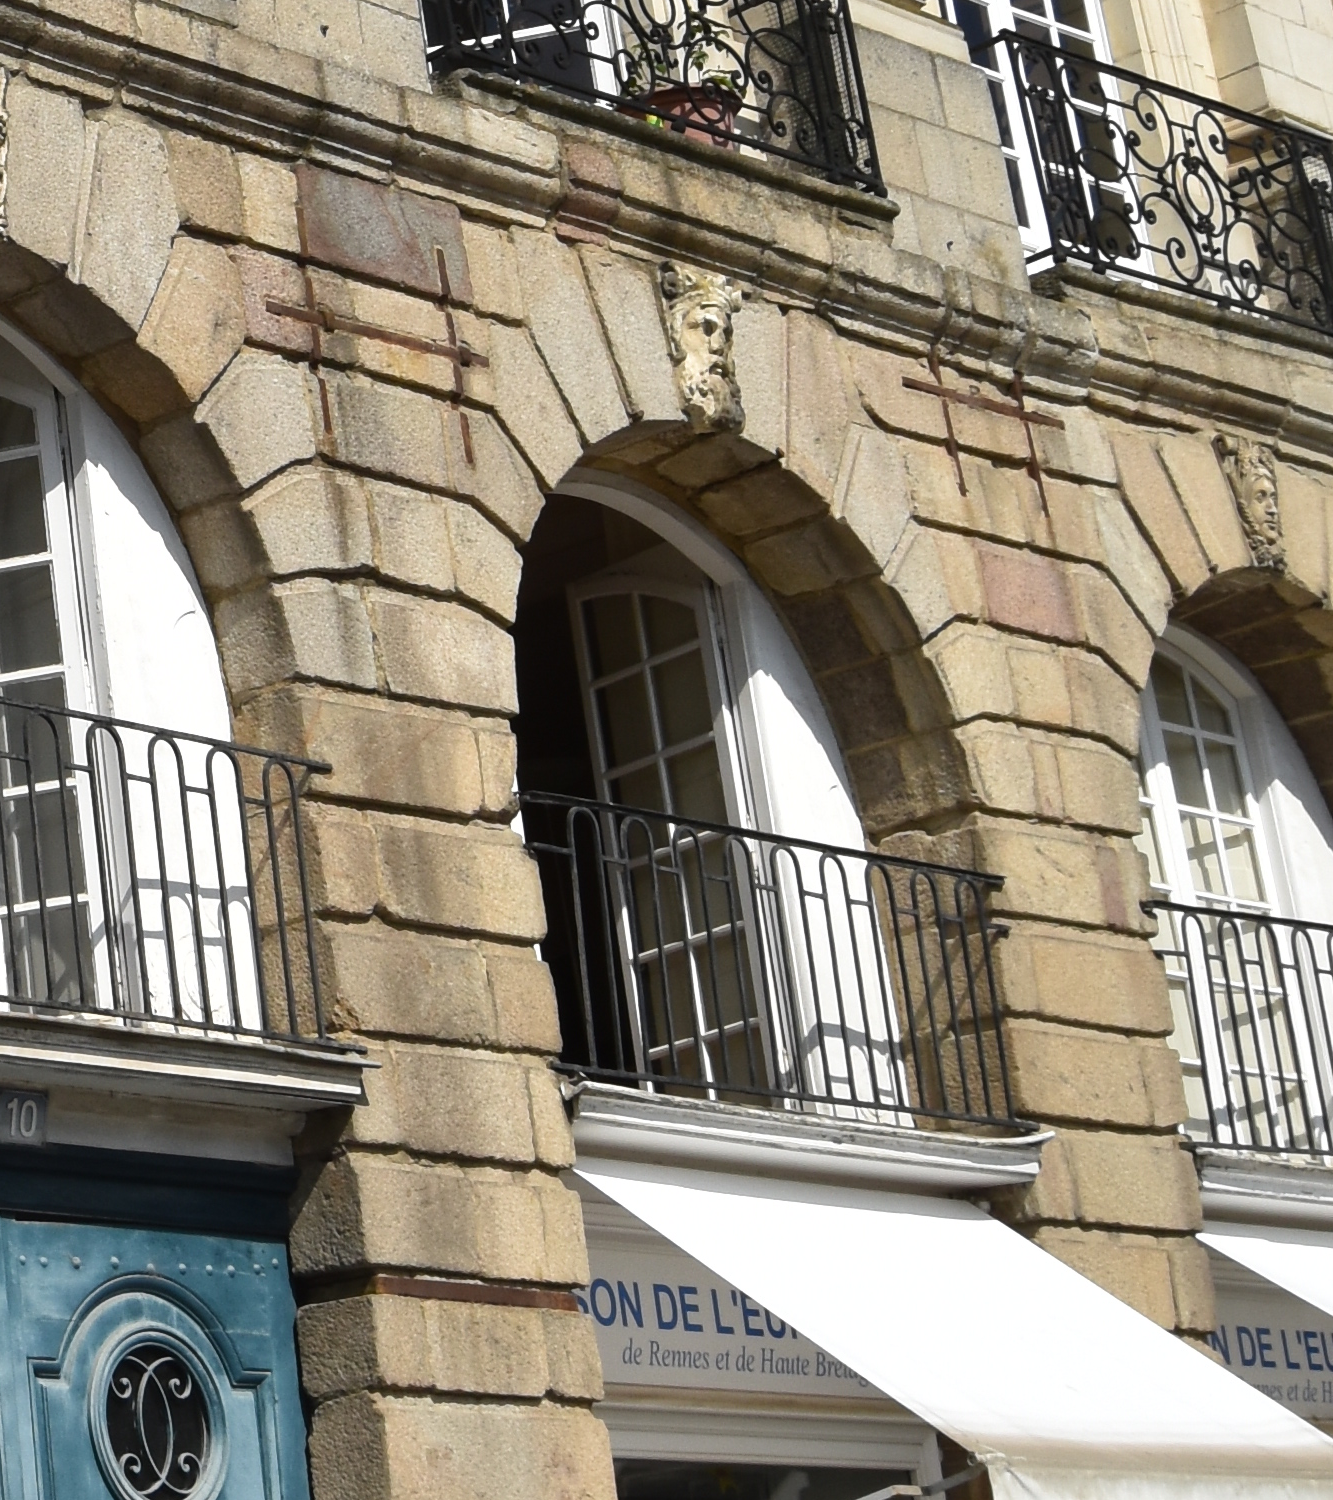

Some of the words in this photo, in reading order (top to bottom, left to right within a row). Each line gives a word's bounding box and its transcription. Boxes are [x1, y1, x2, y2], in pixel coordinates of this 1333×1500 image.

[6, 1097, 39, 1141] 10
[652, 1283, 704, 1332] DE
[622, 1338, 642, 1366] de
[649, 1340, 710, 1369] Rennes
[715, 1352, 730, 1371] et
[736, 1346, 755, 1373] de
[761, 1347, 810, 1377] Haute
[1236, 1326, 1277, 1368] DE
[1287, 1384, 1299, 1402] et
[1302, 1379, 1318, 1402] de
